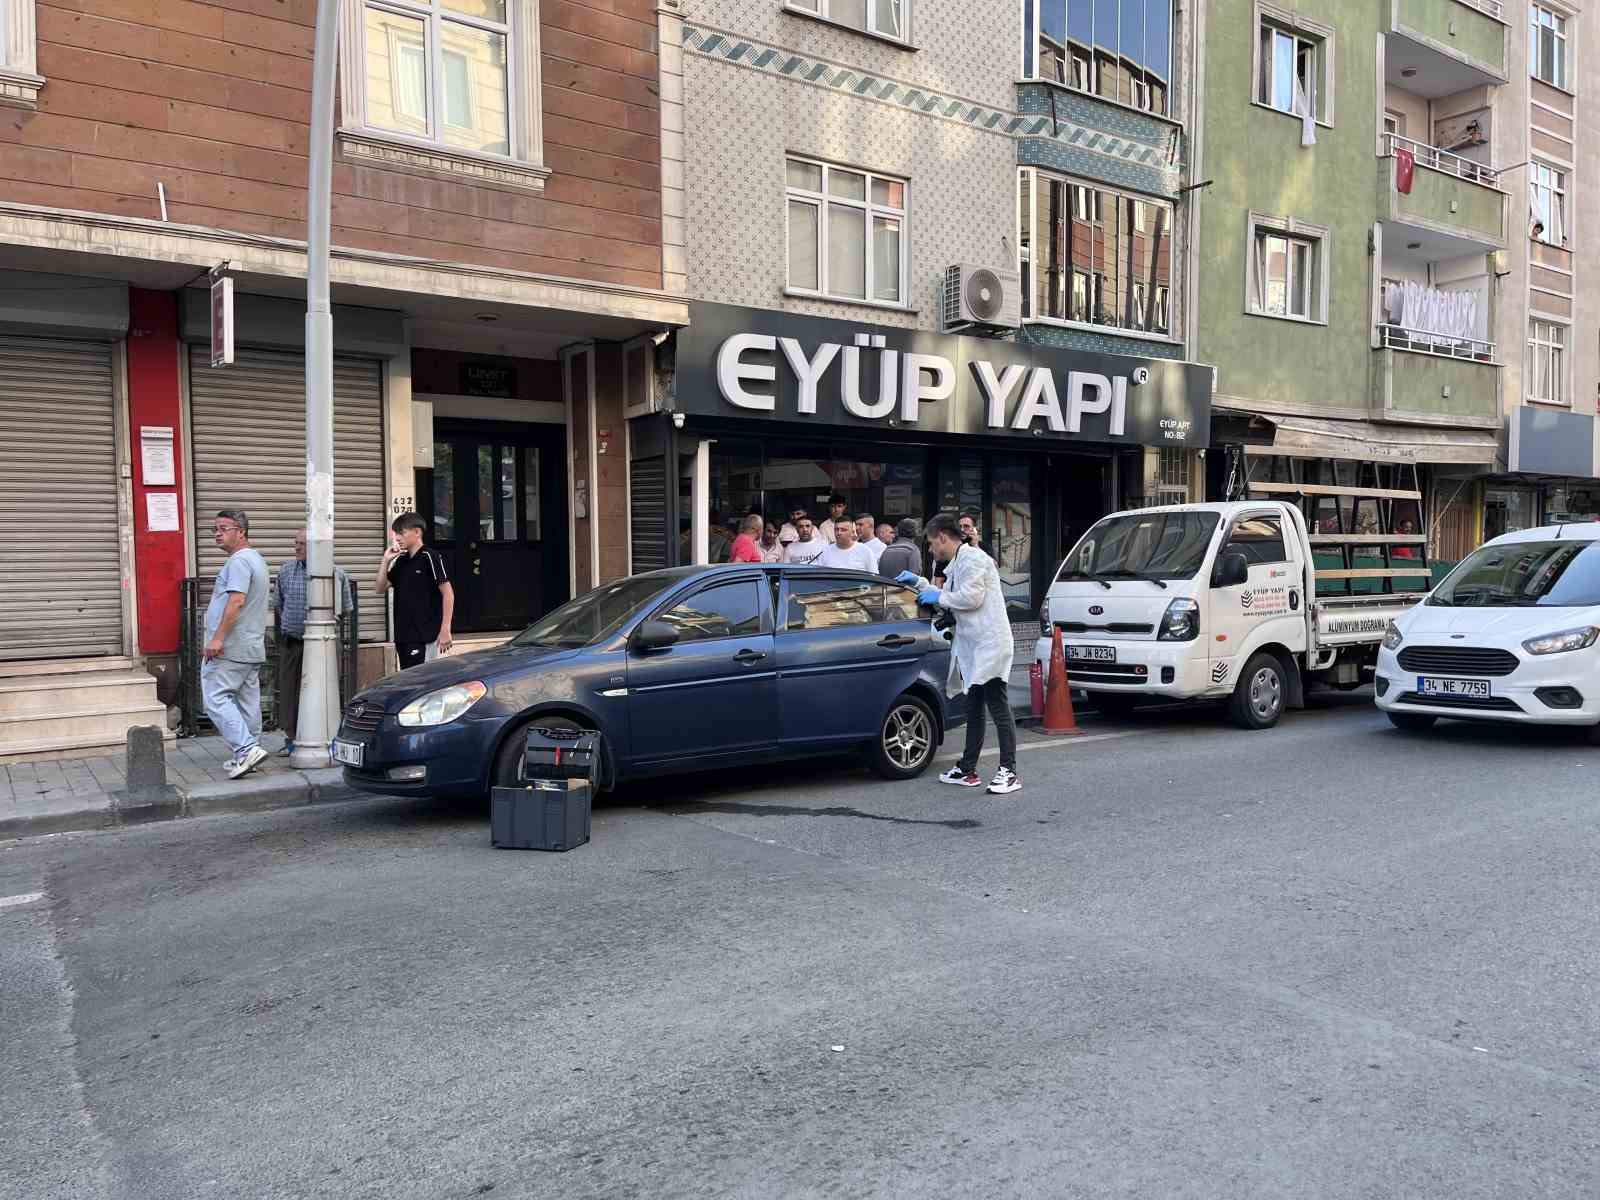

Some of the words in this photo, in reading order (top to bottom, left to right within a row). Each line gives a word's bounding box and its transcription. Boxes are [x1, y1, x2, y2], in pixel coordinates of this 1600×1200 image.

[717, 333, 956, 422] EYÜP
[971, 360, 1127, 436] YAPI
[1069, 647, 1079, 657] 34
[1094, 648, 1113, 659] 8234
[1425, 679, 1437, 691] 34
[1442, 681, 1456, 693] NE
[1460, 681, 1488, 695] 7759
